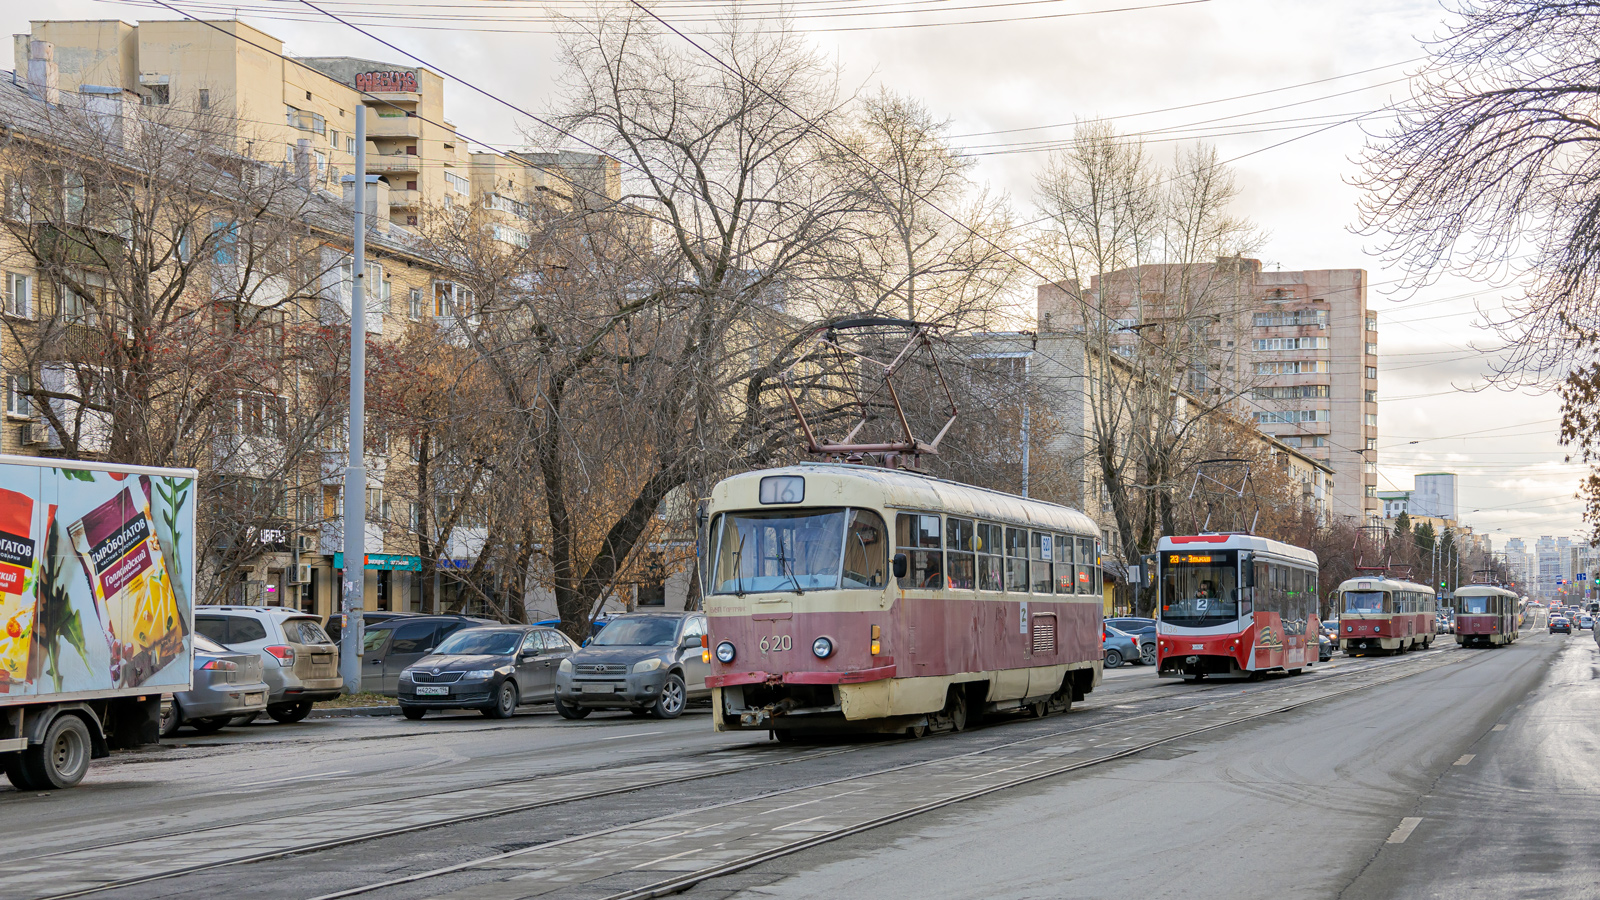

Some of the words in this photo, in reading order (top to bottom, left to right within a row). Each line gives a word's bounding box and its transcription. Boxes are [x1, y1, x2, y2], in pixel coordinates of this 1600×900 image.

[773, 480, 795, 502] 16
[92, 518, 146, 564] СЫРОБОГАТОВ
[260, 529, 286, 544] ЦВЕТЫ
[0, 538, 32, 557] ГАТОВ
[105, 549, 146, 587] Голландский
[1198, 600, 1207, 608] 2
[1021, 607, 1026, 622] 2
[759, 635, 793, 652] 620
